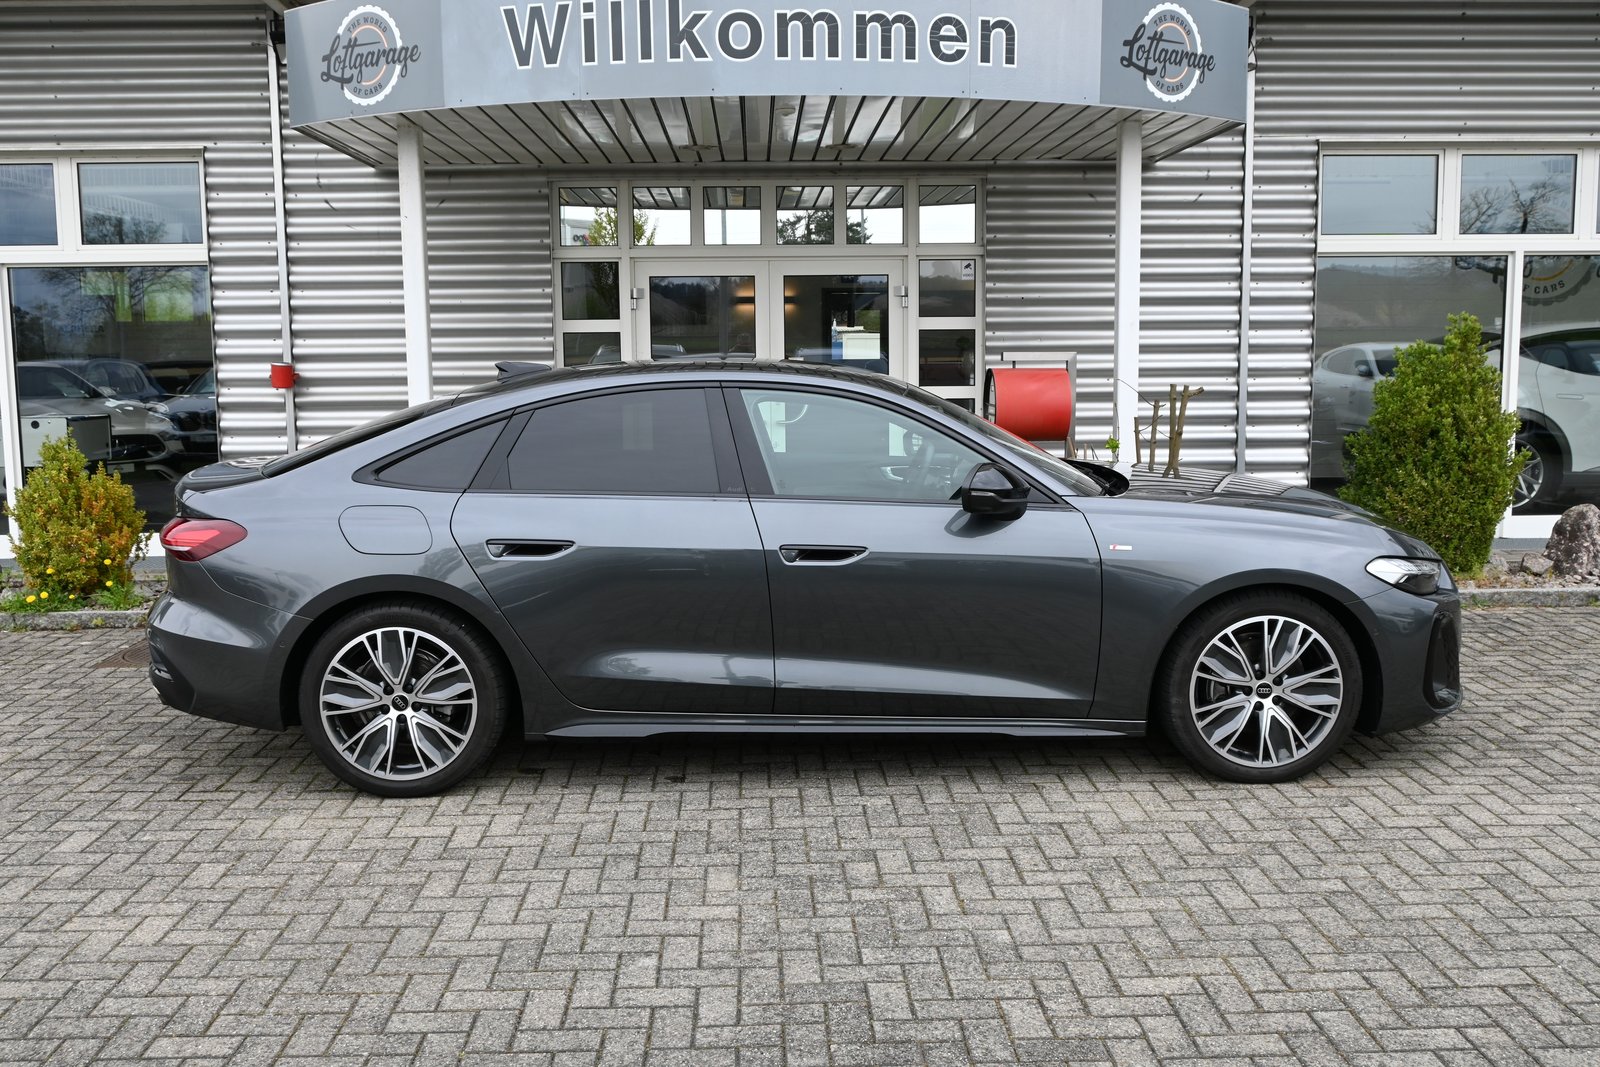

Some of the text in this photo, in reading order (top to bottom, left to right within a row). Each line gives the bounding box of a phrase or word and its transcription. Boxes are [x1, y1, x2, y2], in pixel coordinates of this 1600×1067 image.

[347, 16, 388, 33] THE WORLD
[1154, 14, 1191, 36] THE WORLD
[499, 0, 1018, 71] Willkommen
[321, 34, 421, 91] Loftgarage
[1120, 22, 1216, 84] Loftgarage
[353, 82, 383, 96] OF CARS
[1156, 80, 1184, 92] OF CARS
[1534, 280, 1565, 295] CARS
